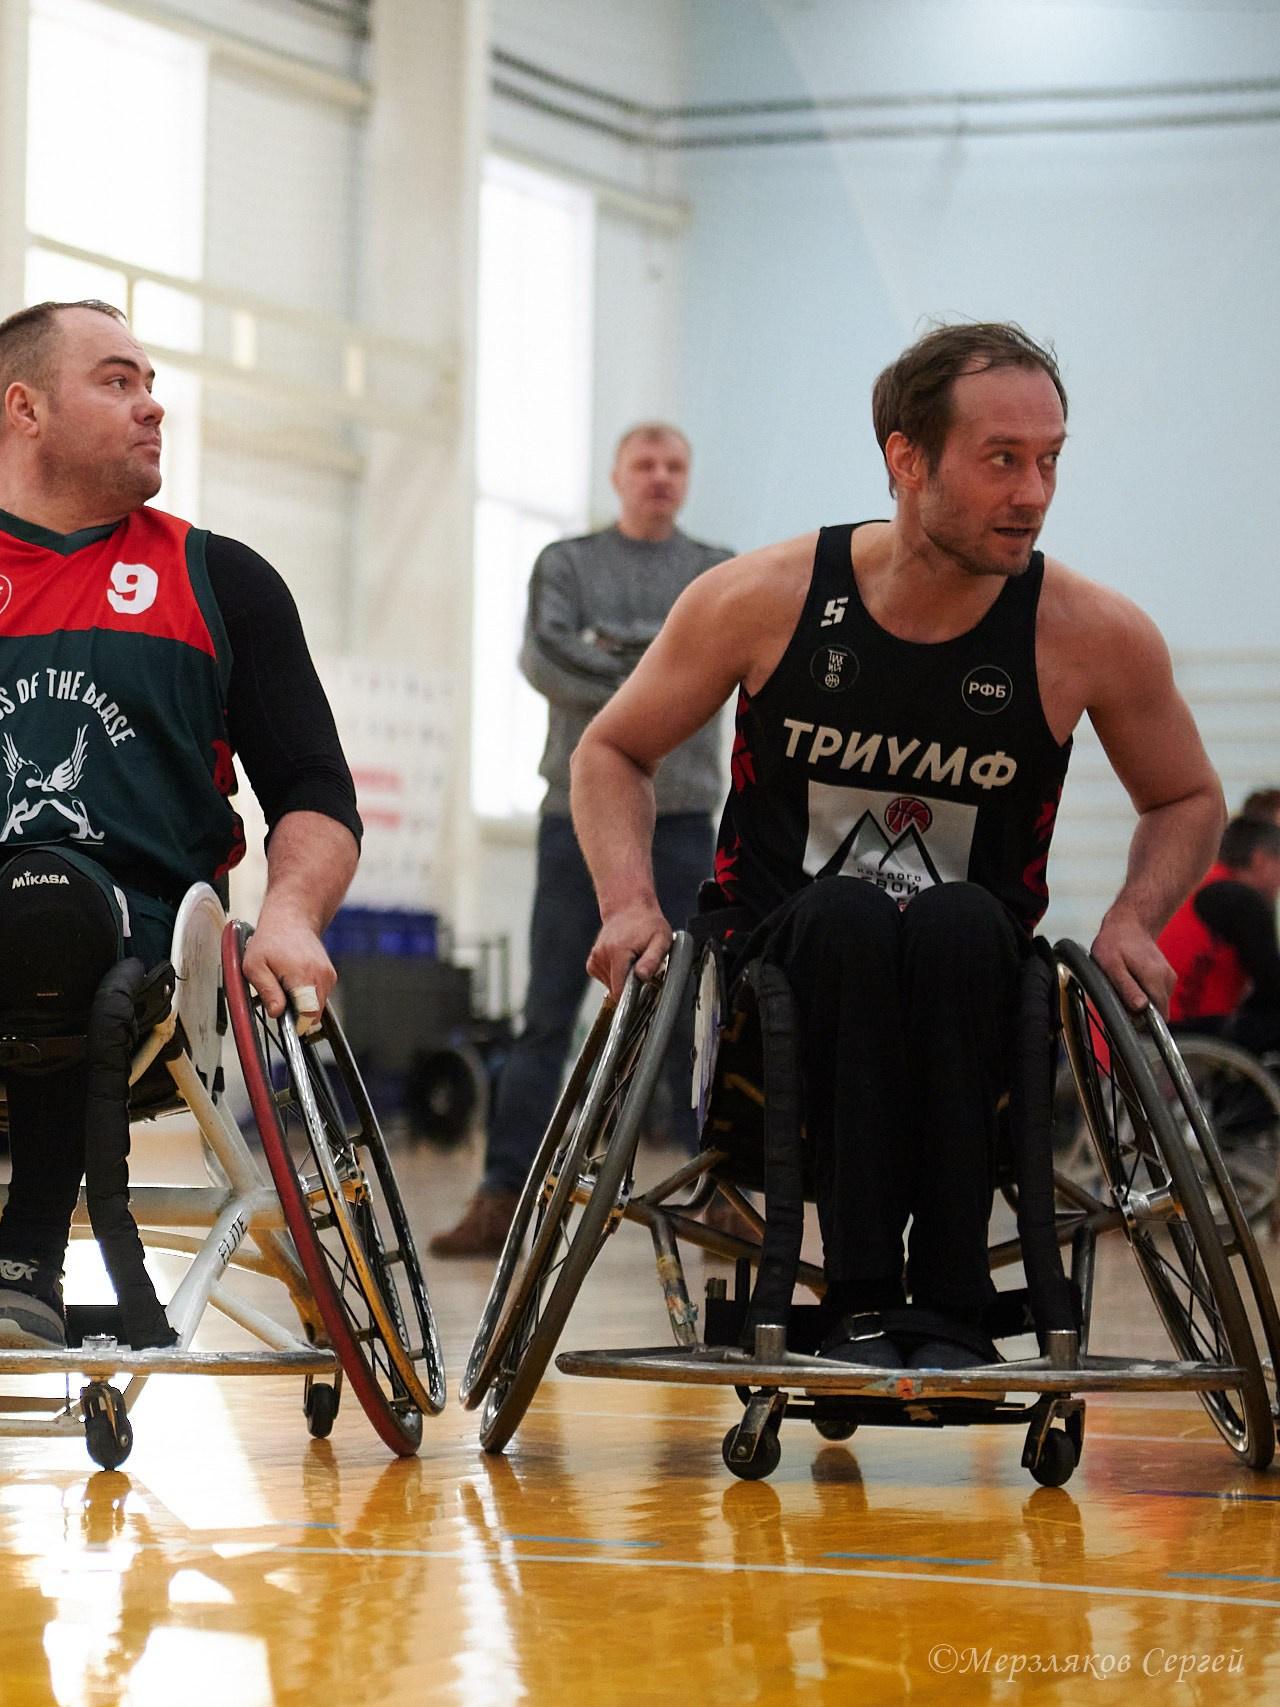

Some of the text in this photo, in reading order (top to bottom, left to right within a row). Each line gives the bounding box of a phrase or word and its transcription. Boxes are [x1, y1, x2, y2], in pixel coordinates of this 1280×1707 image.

[107, 561, 158, 615] 9
[16, 672, 39, 704] OF
[46, 668, 85, 700] THE
[968, 682, 1007, 699] РФБ
[783, 718, 1017, 790] ТРИУМФ
[860, 876, 920, 895] ВОЙ
[218, 1211, 248, 1265] ELITE
